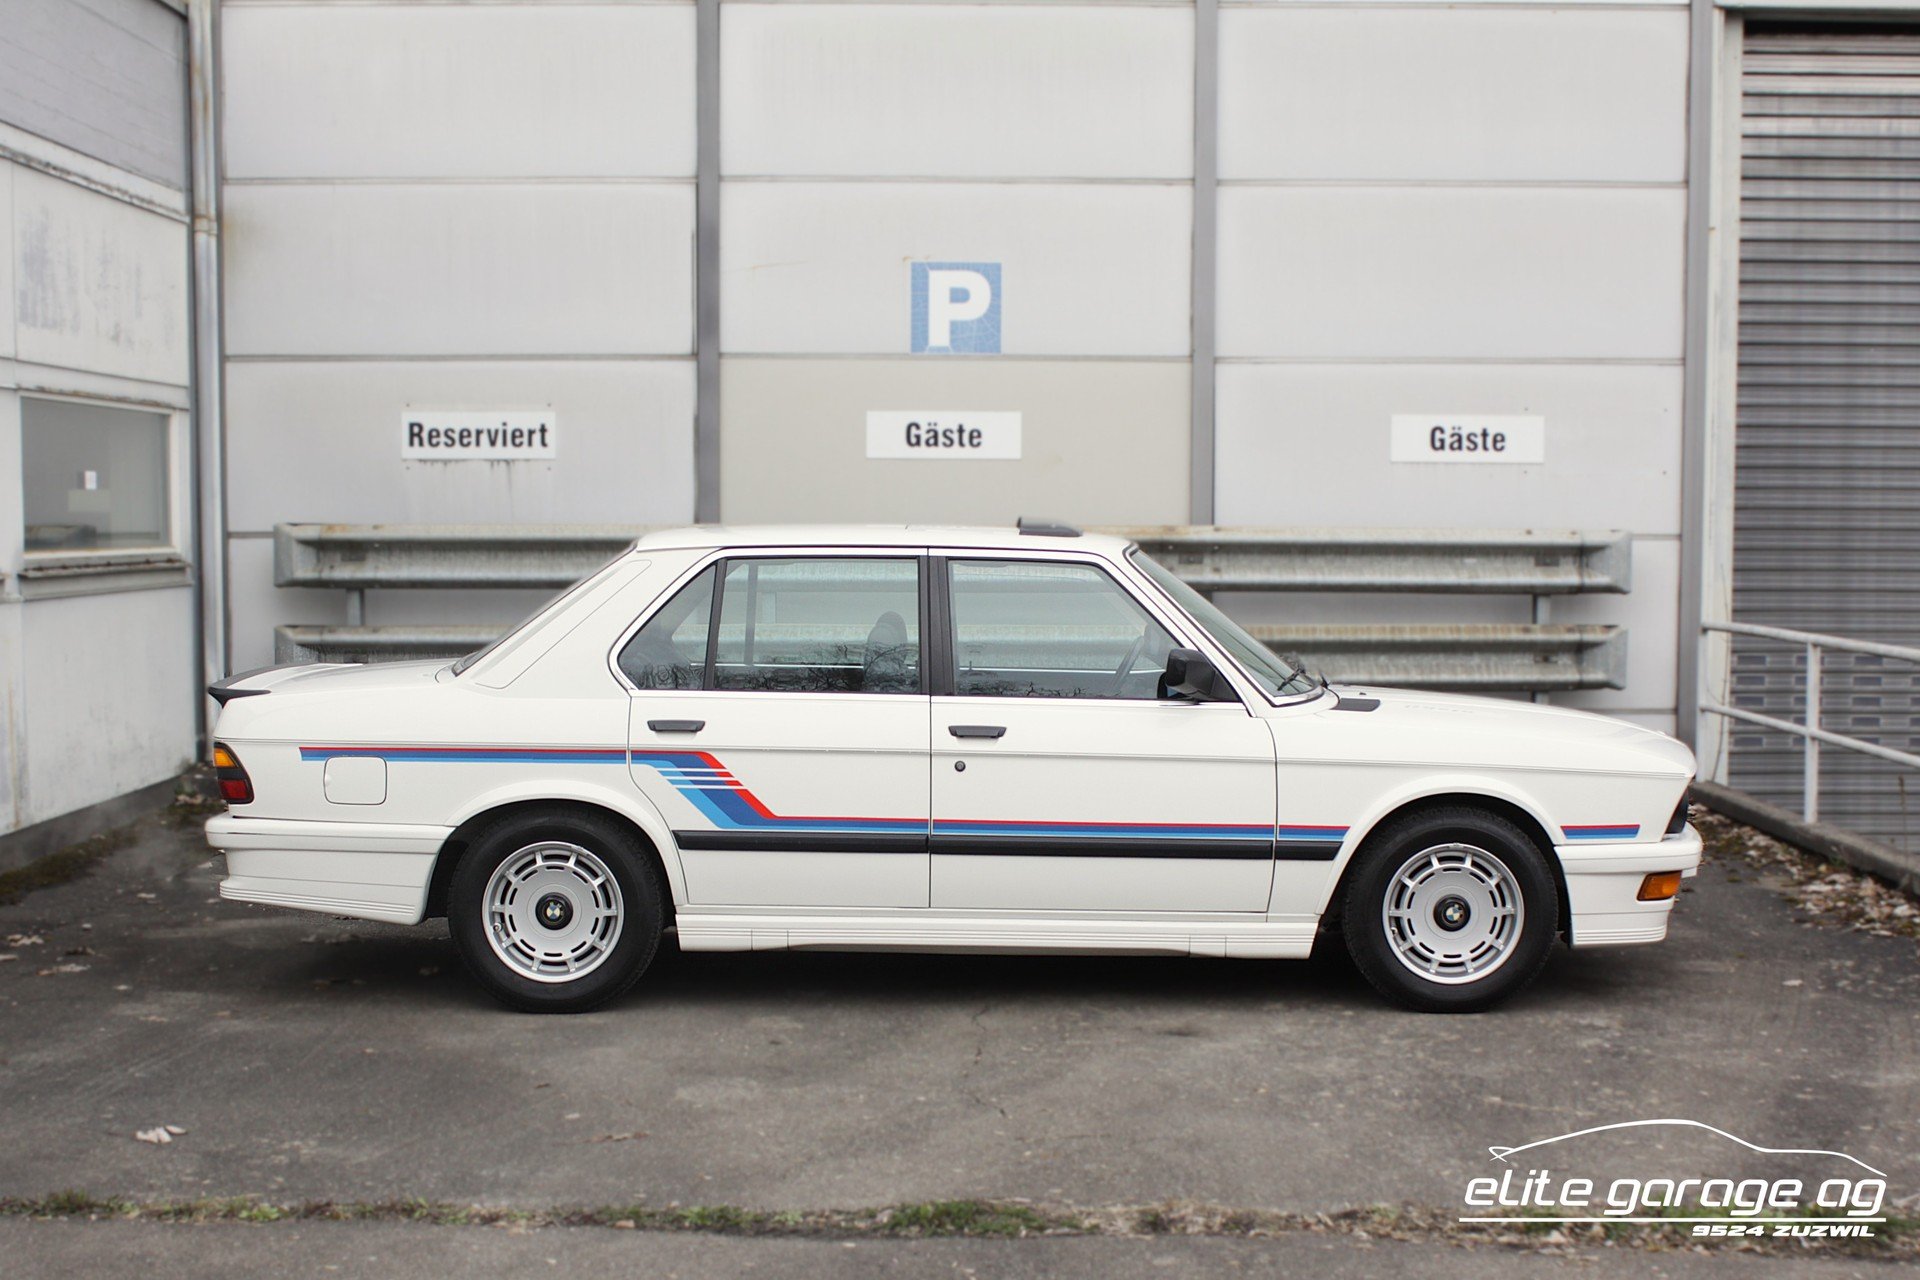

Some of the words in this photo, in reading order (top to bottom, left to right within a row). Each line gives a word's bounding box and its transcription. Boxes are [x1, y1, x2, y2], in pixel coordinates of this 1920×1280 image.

[928, 269, 991, 347] P
[408, 422, 548, 448] Reserviert
[905, 422, 982, 448] Gäste
[1430, 426, 1506, 452] Gäste
